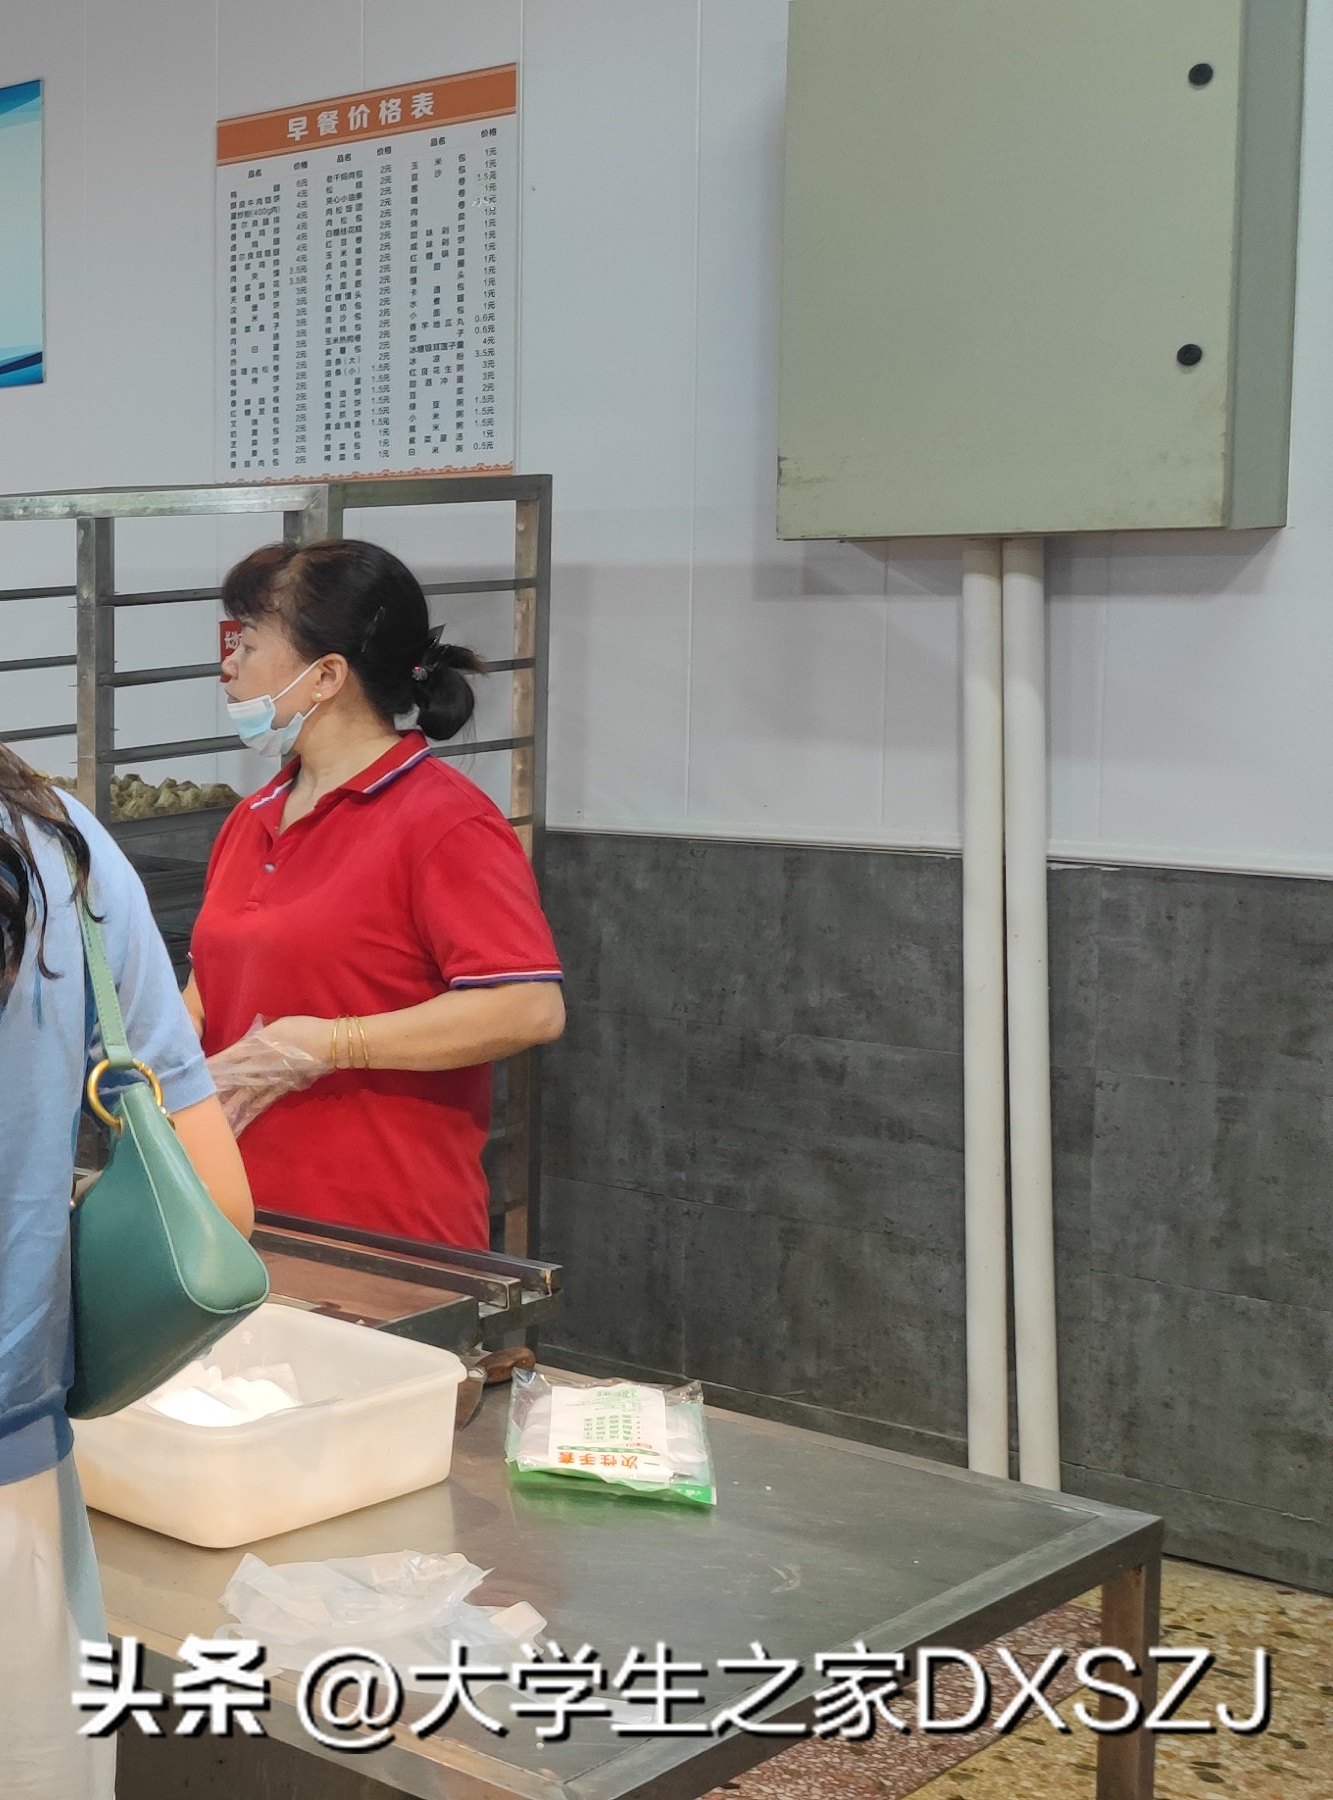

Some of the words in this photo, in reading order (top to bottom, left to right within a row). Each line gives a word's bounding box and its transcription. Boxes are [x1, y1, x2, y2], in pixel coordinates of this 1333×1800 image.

[287, 92, 435, 142] 早餐价格表
[480, 127, 497, 138] 价格
[376, 145, 392, 156] 价格
[293, 160, 308, 171] 价格
[558, 1451, 661, 1471] 一次性手套
